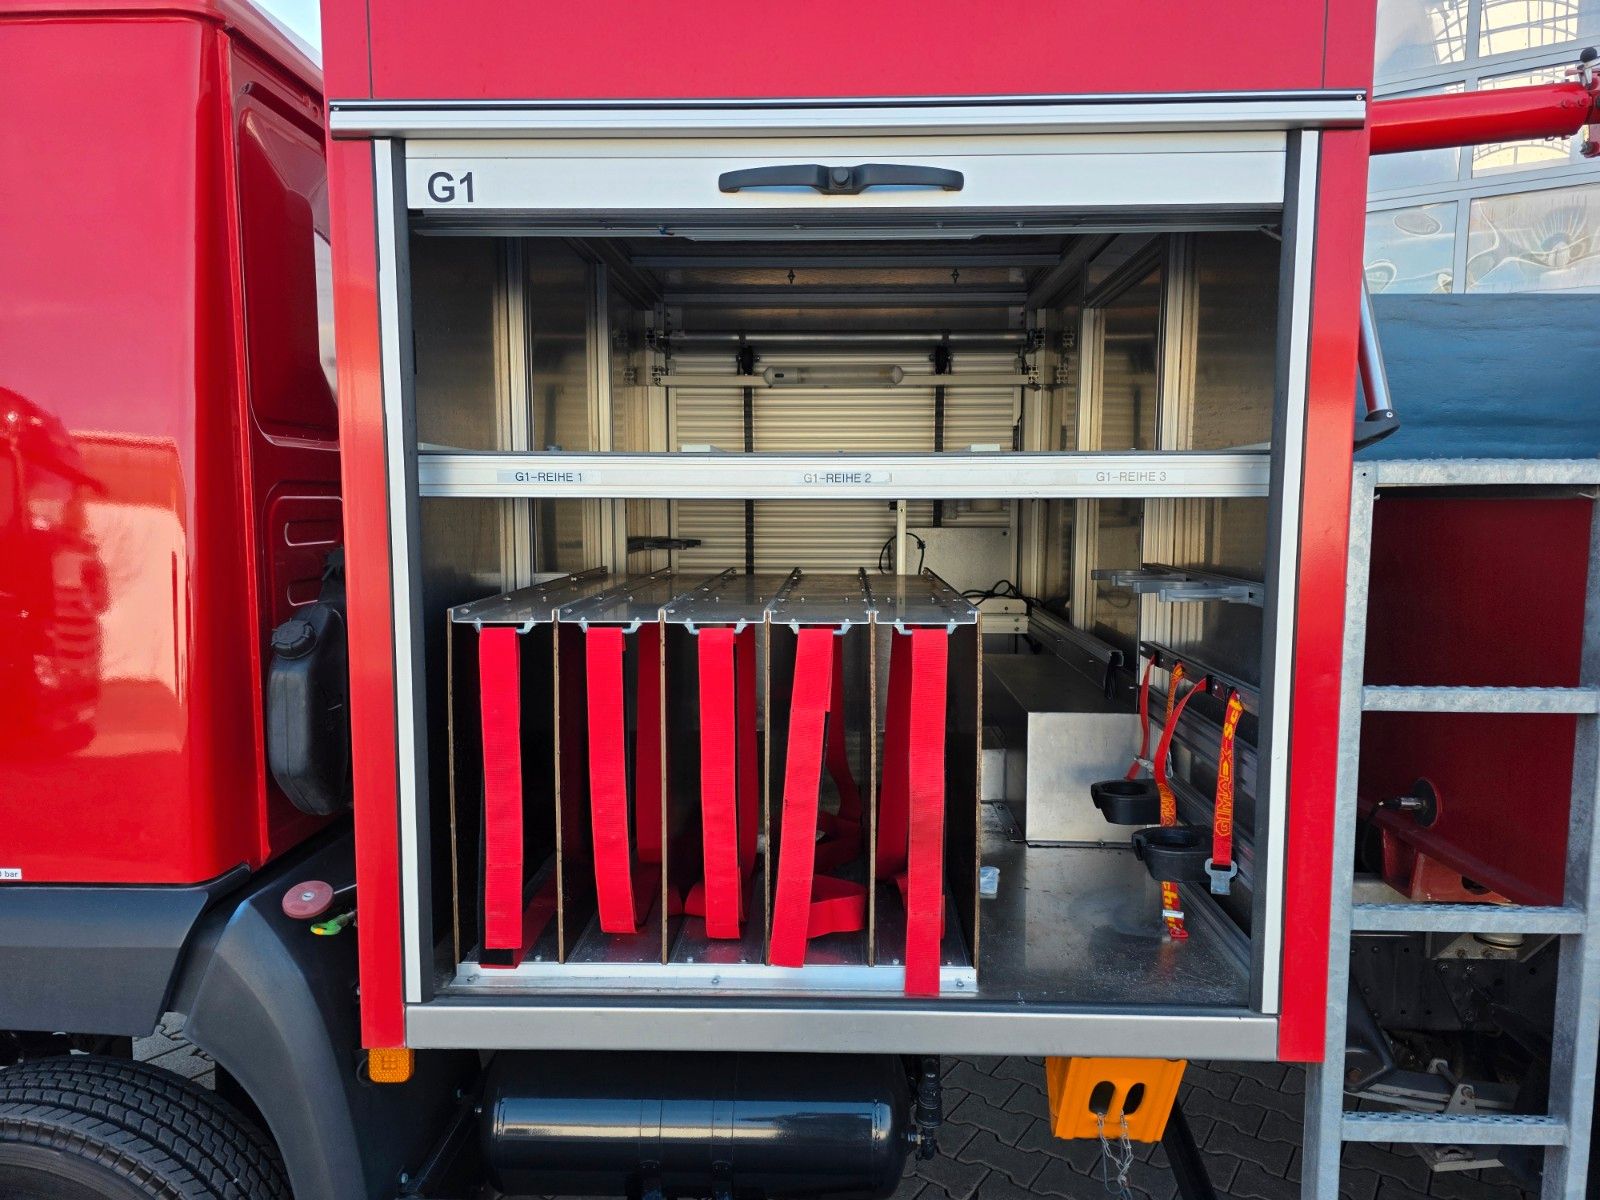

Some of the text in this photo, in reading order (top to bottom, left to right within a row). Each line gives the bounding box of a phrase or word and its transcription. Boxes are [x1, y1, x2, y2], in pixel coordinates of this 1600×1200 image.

[427, 171, 474, 203] G1
[515, 471, 582, 482] G1-REIHE 1
[803, 473, 872, 483] G1-REIHE 2
[1096, 471, 1167, 482] G1-REIHE 3
[4, 870, 18, 878] bar
